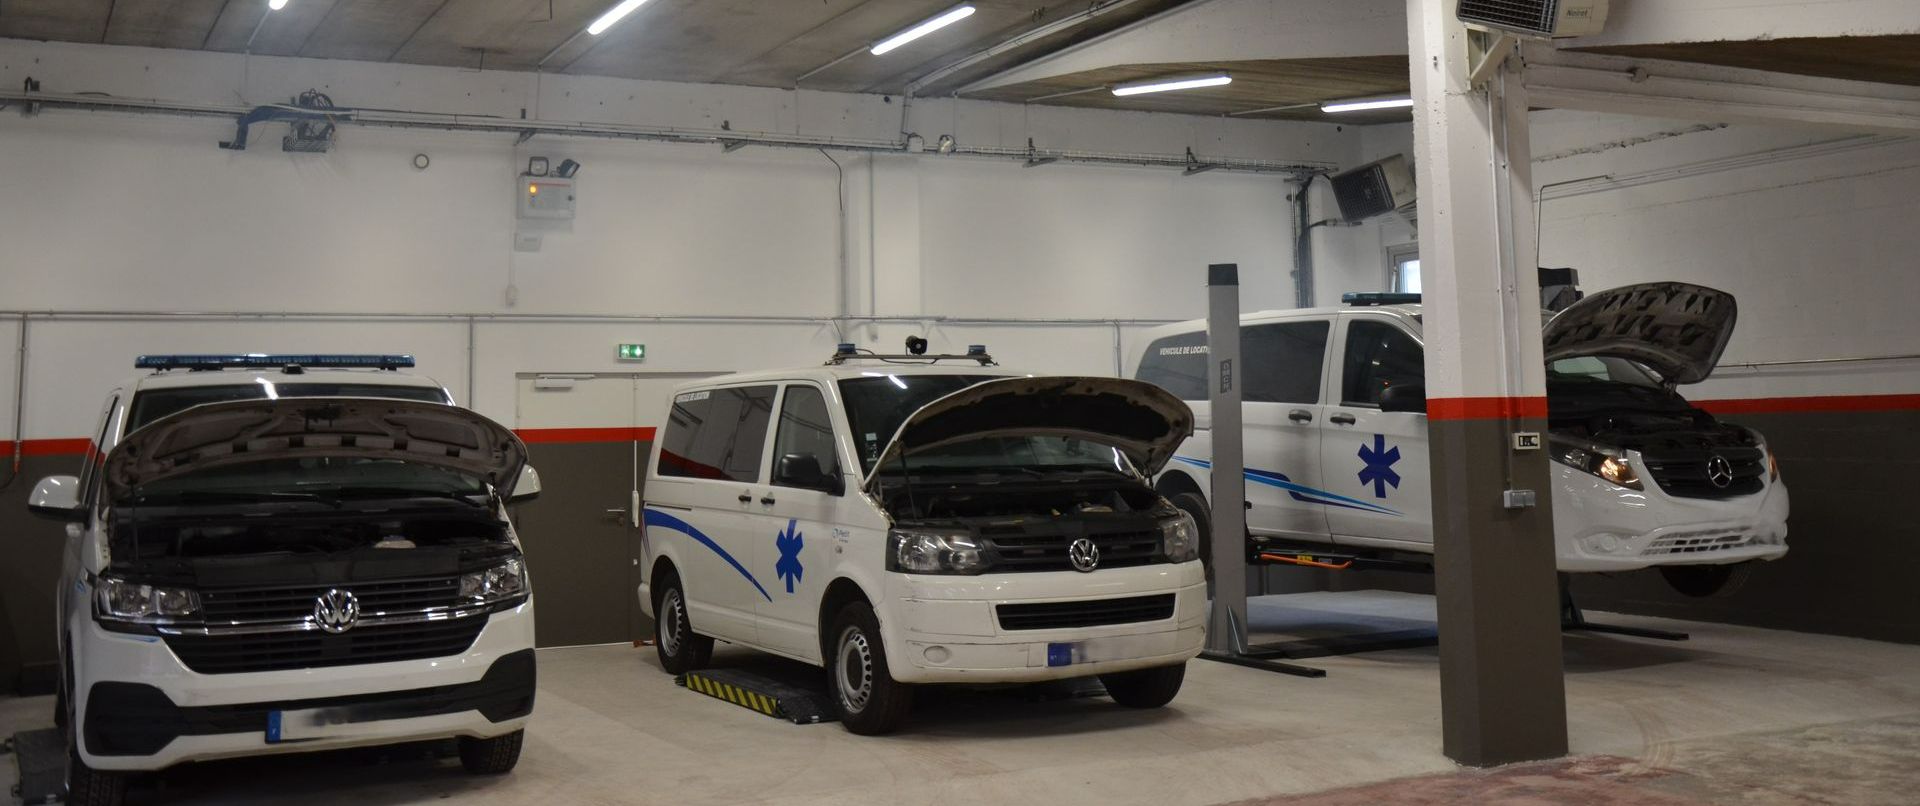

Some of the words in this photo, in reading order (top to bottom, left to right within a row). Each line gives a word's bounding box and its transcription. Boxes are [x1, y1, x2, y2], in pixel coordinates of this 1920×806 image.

[1160, 347, 1182, 356] VEHICULE
[1183, 346, 1190, 354] DE
[1190, 345, 1209, 354] LOCATI
